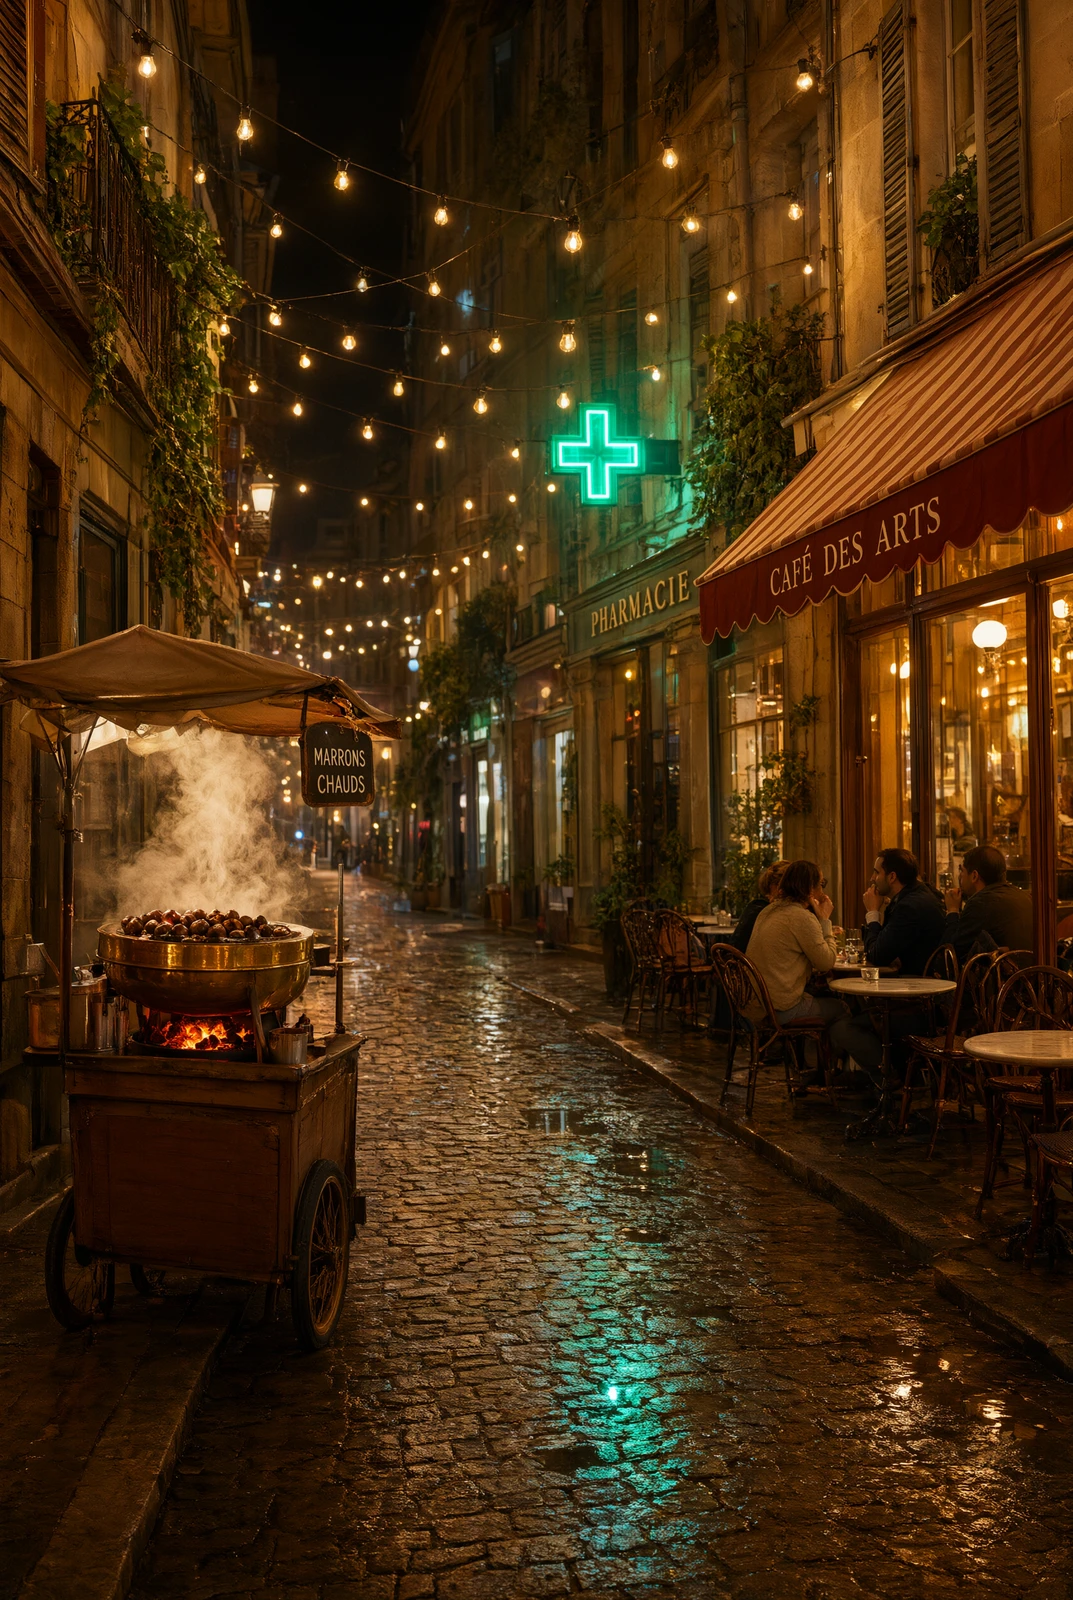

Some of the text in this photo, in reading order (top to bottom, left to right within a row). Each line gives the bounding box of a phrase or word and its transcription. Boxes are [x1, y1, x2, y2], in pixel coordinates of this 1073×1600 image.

[770, 496, 941, 596] CAFÉ DES ARTS
[591, 570, 690, 637] PHARMACIE
[314, 747, 366, 767] MARRONS
[317, 774, 366, 794] CHAUDS
